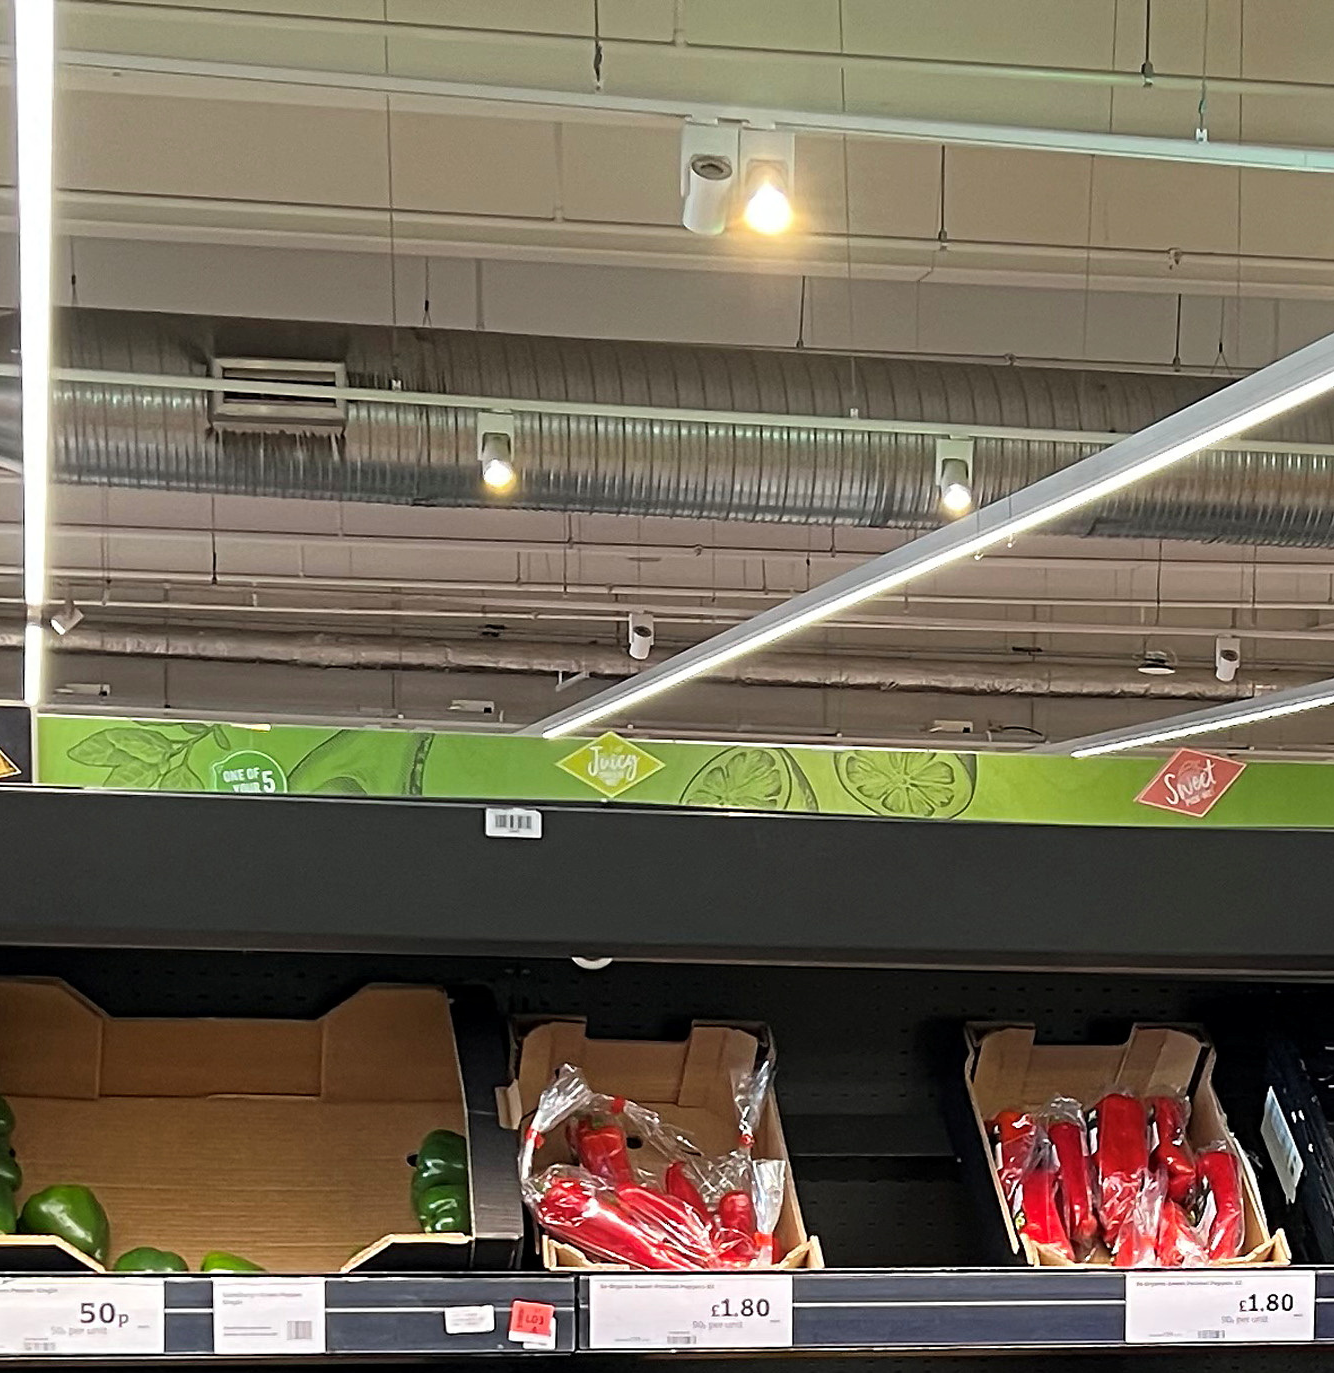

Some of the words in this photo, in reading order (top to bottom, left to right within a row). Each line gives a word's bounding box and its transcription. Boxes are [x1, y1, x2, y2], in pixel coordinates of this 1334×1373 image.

[223, 769, 245, 782] ONE
[246, 767, 260, 780] OF
[587, 746, 640, 781] Juicy
[262, 770, 276, 793] 5
[1164, 759, 1217, 805] Sweet
[711, 1298, 770, 1318] £1.80
[1239, 1293, 1294, 1313] £1.80
[80, 1302, 129, 1328] 50p
